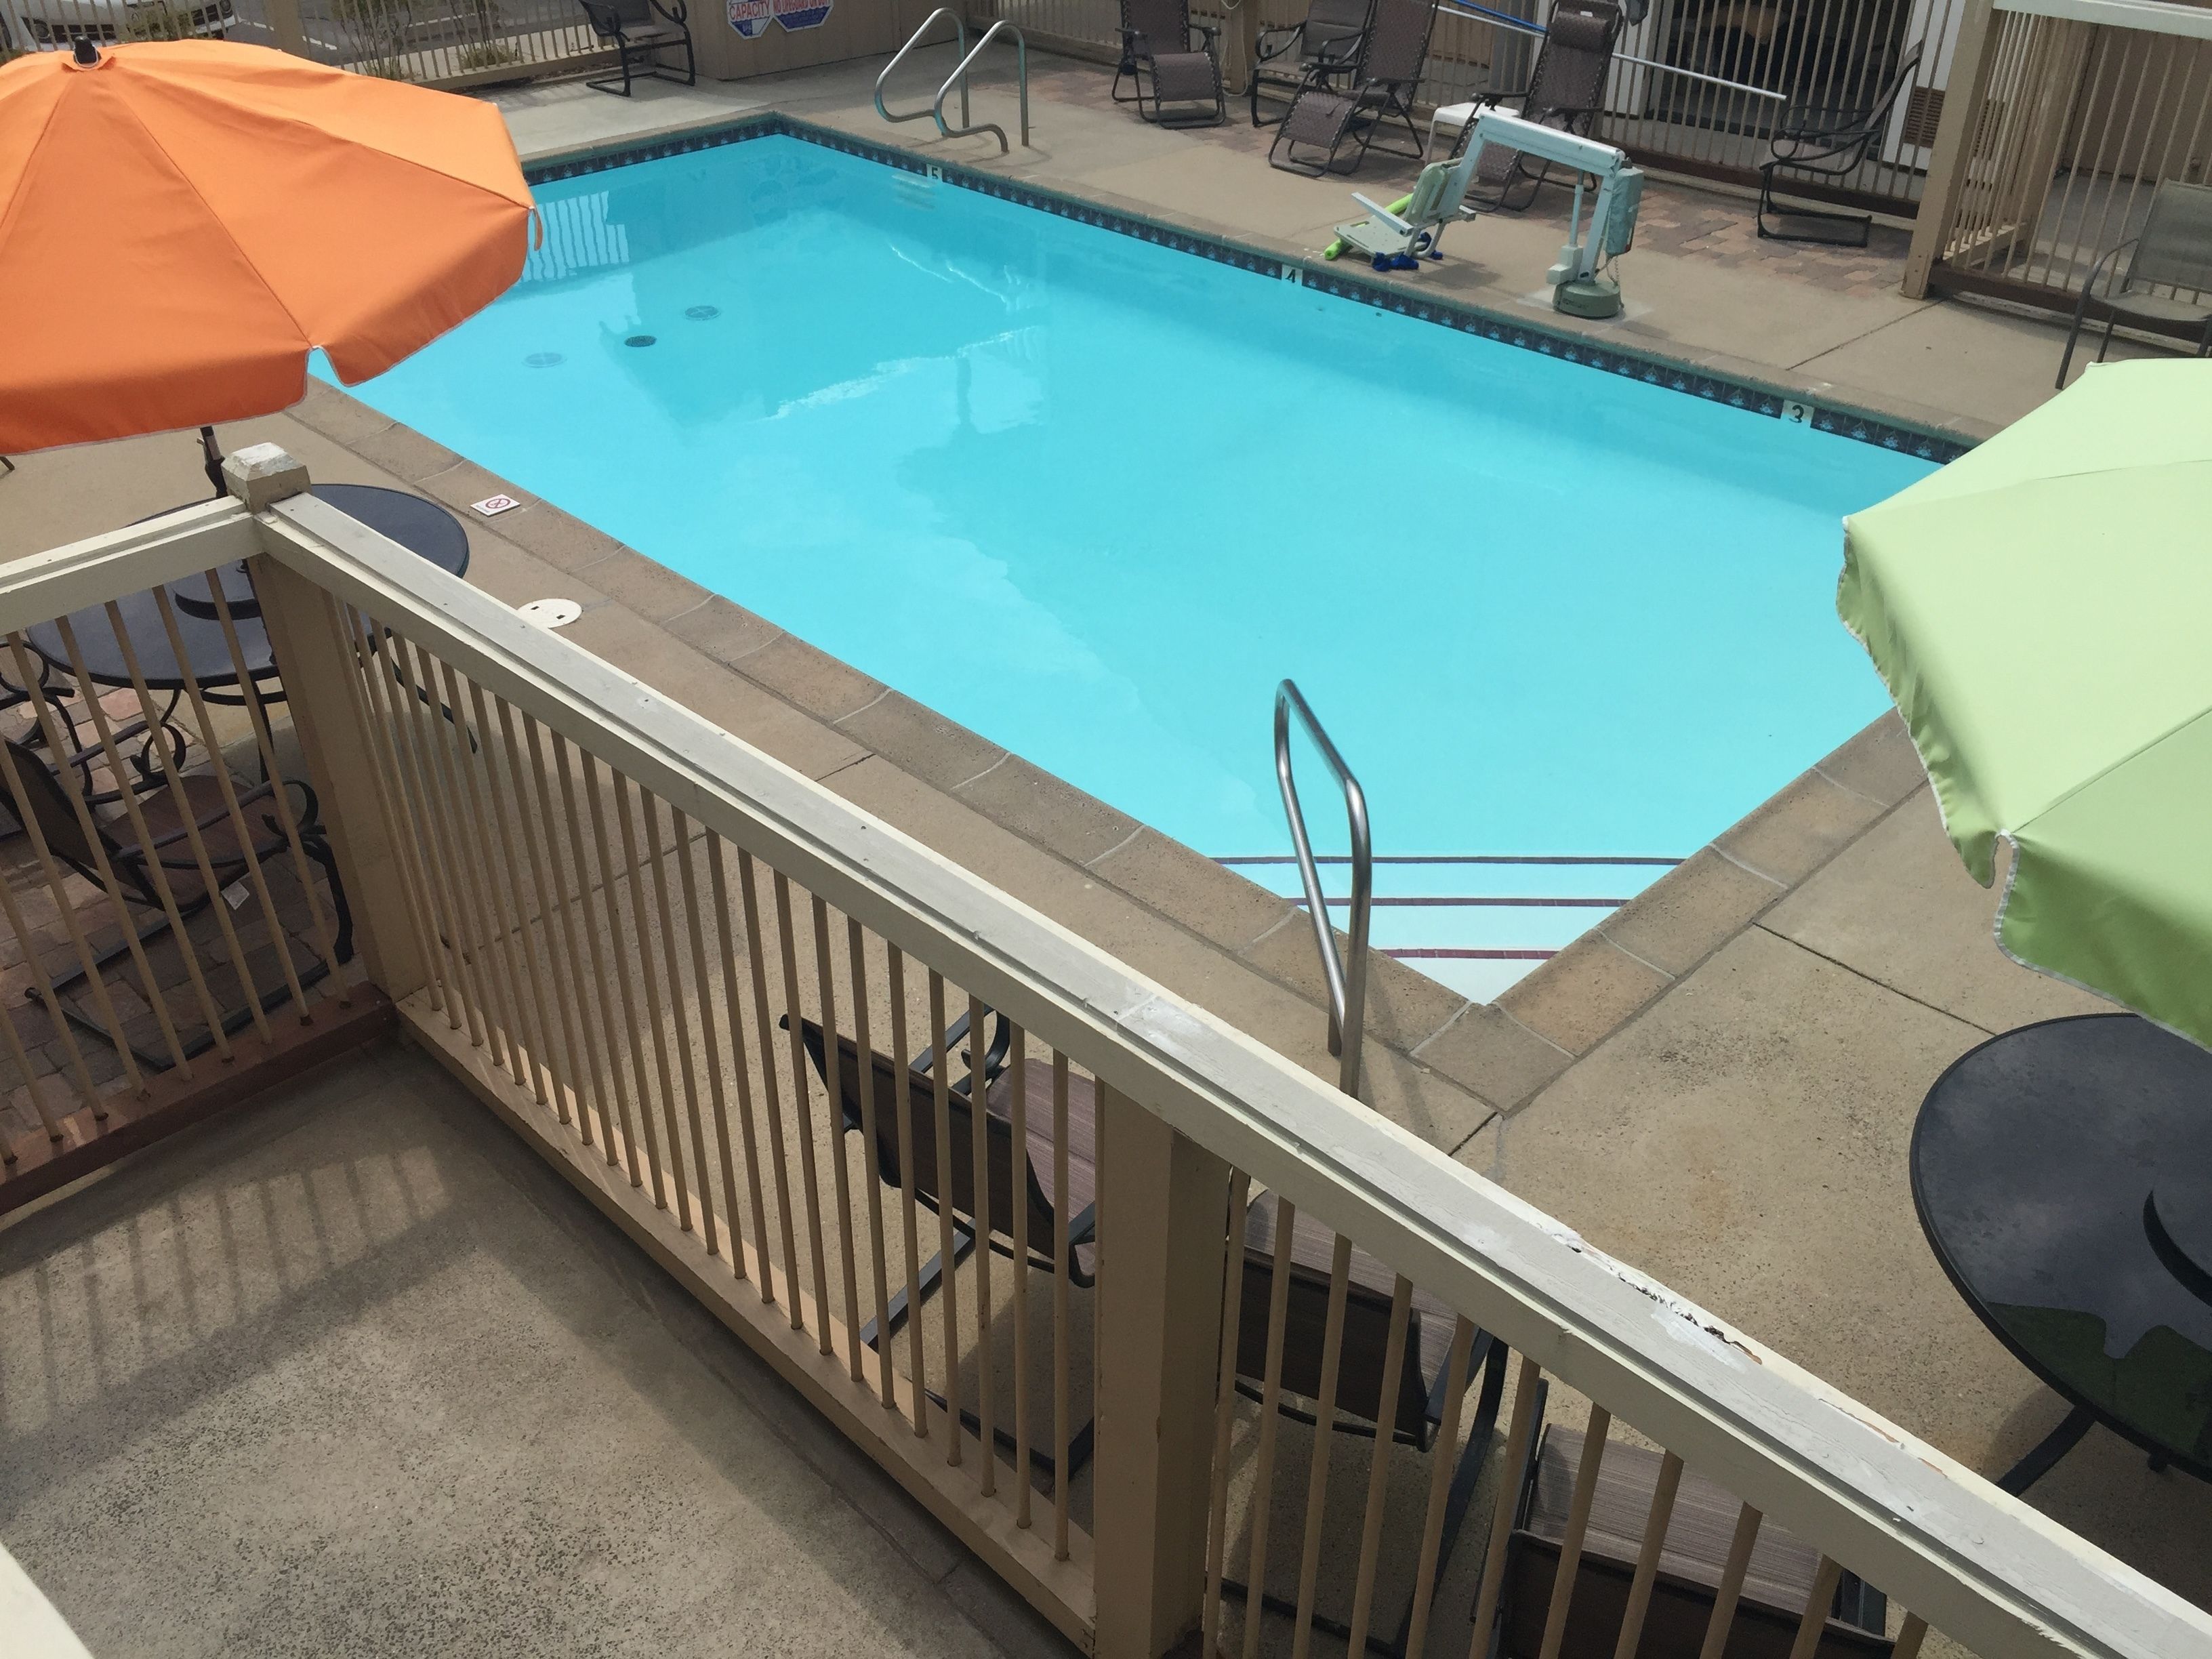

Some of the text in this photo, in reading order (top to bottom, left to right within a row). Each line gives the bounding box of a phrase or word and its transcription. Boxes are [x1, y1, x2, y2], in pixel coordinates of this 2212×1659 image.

[729, 1, 769, 20] CAPACITY
[932, 167, 939, 180] 5
[1285, 269, 1296, 283] 4
[1789, 405, 1804, 423] 3
